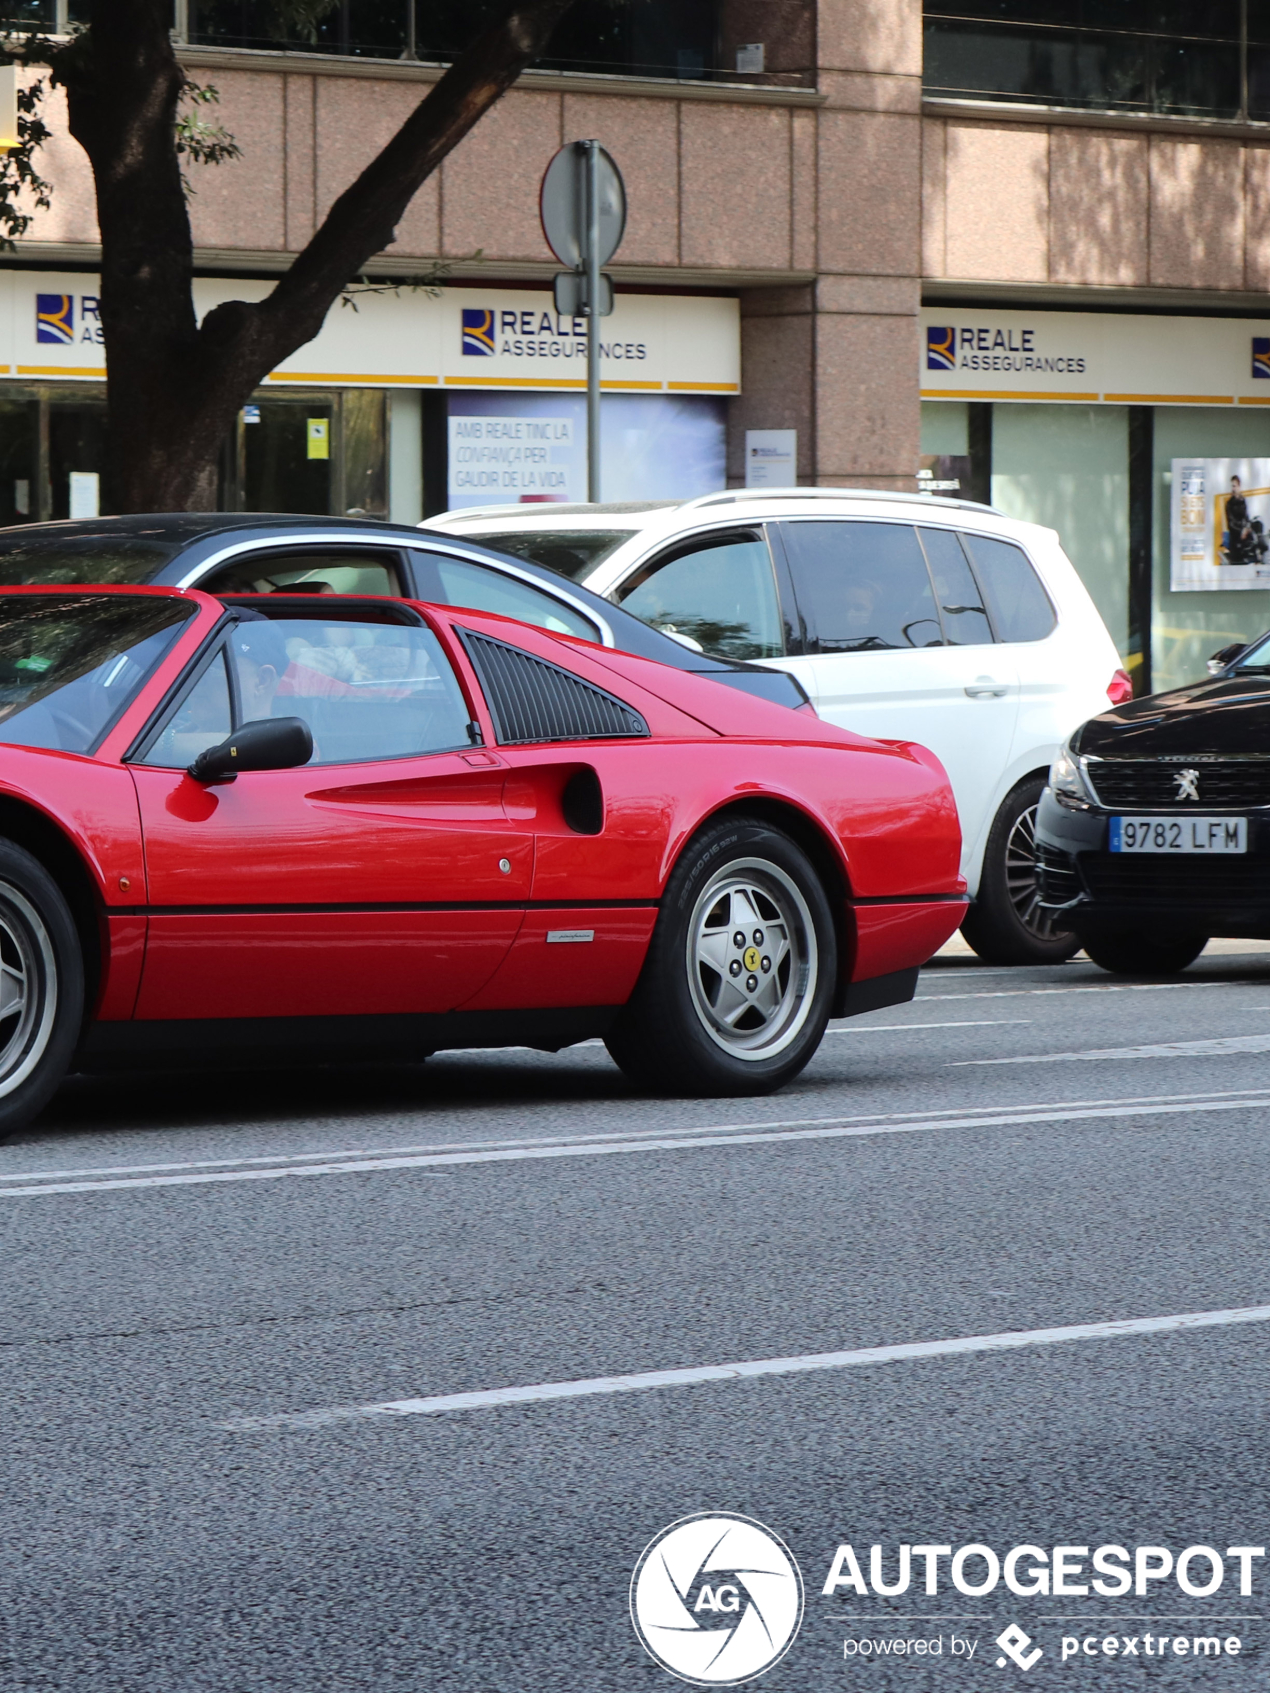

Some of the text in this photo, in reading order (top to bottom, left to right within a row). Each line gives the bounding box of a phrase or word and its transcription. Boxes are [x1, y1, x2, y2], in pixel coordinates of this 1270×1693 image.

[501, 310, 588, 337] REALE
[501, 340, 647, 360] ASSEGURNCES
[960, 328, 1035, 352] REALE
[959, 355, 1086, 373] ASSEGURANCES
[456, 422, 569, 439] AMB REALE TINC LA
[457, 446, 547, 468] CONFIANÇA PER
[456, 470, 567, 487] GAUDIR DE LA VIDA
[1125, 823, 1239, 848] 9782 LFM
